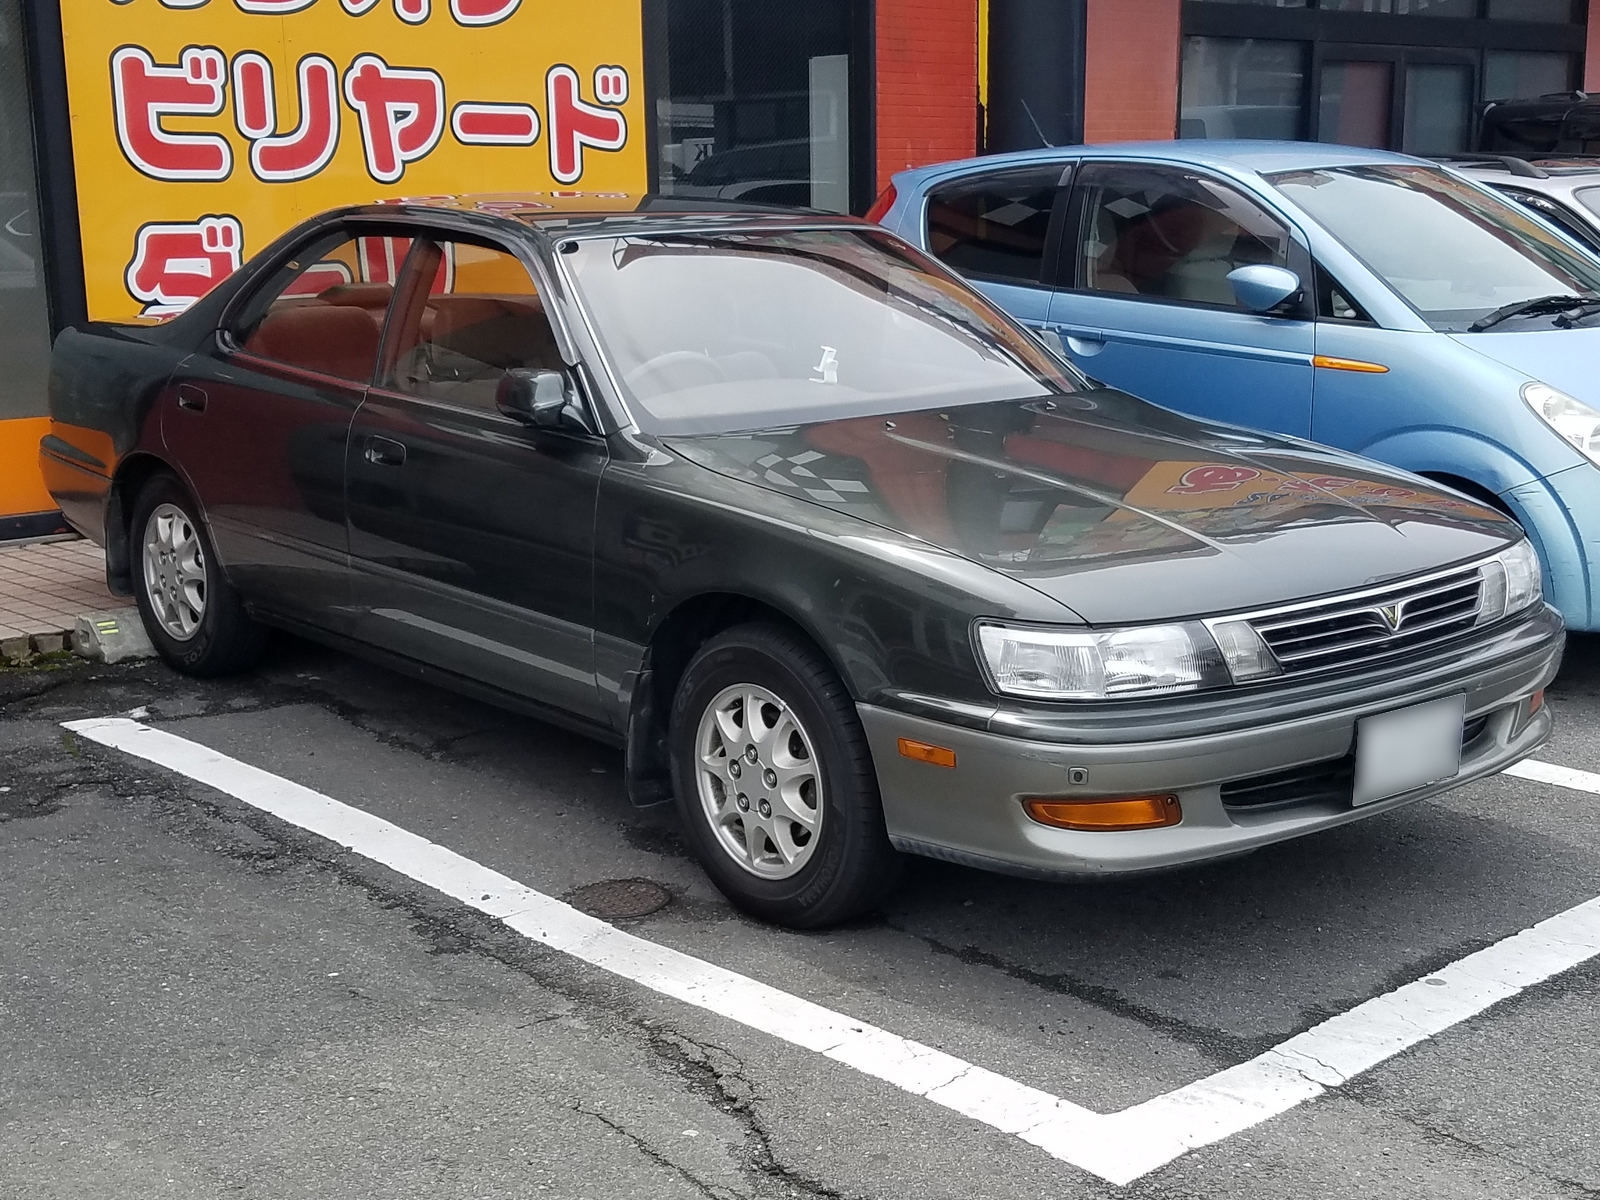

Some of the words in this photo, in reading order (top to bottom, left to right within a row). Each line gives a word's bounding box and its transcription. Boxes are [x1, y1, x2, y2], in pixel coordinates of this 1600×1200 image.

[110, 45, 628, 184] ビリヤード
